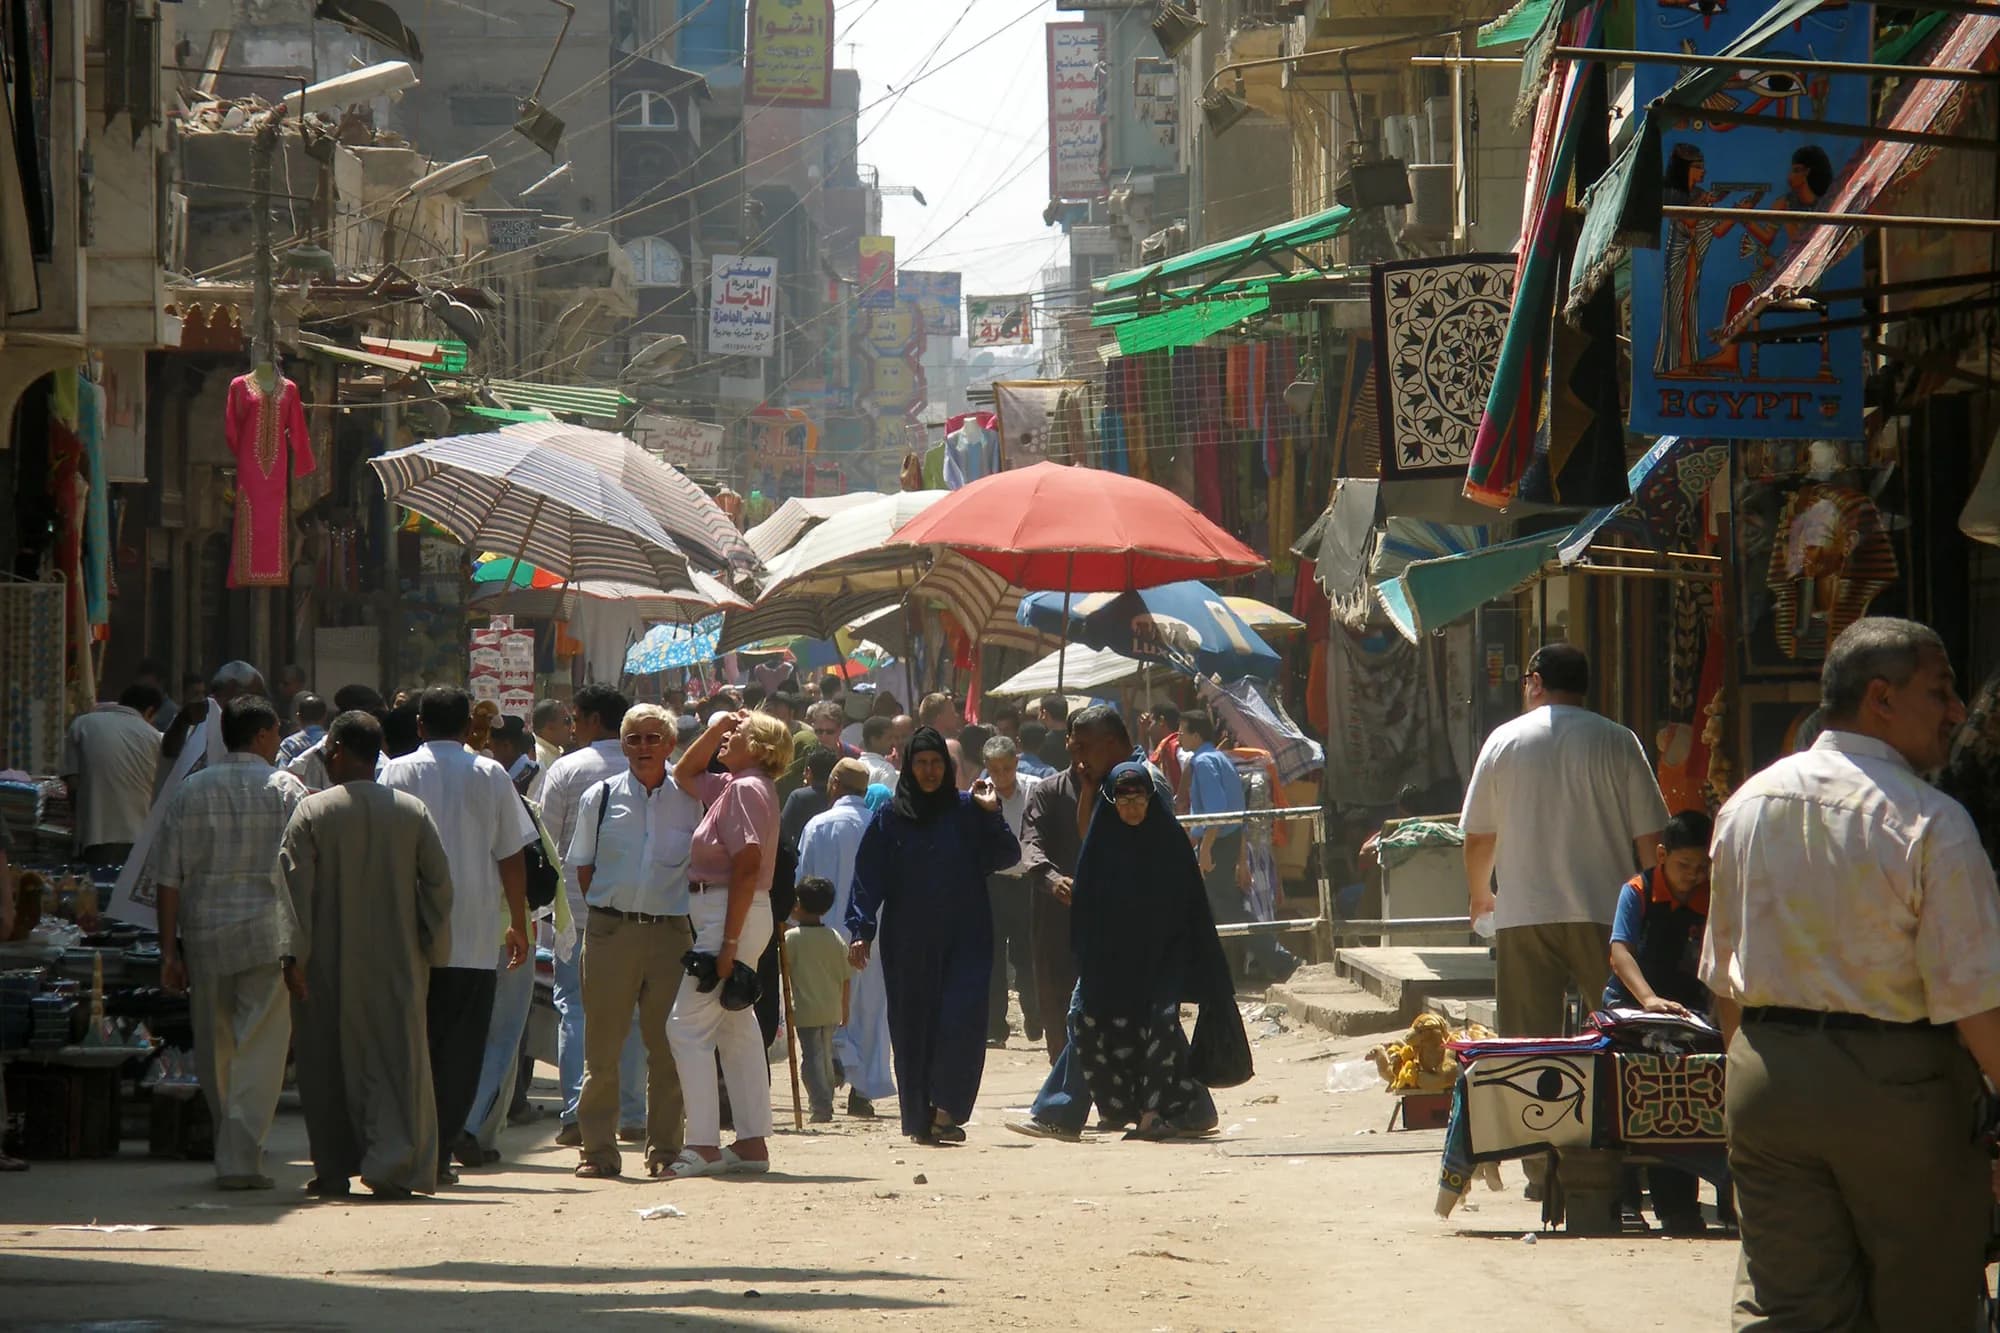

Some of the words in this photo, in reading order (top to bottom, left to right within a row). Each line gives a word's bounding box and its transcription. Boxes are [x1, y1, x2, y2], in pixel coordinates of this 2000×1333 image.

[719, 262, 771, 279] سنتر
[715, 280, 771, 310] النجار
[1657, 387, 1813, 421] EGYPT
